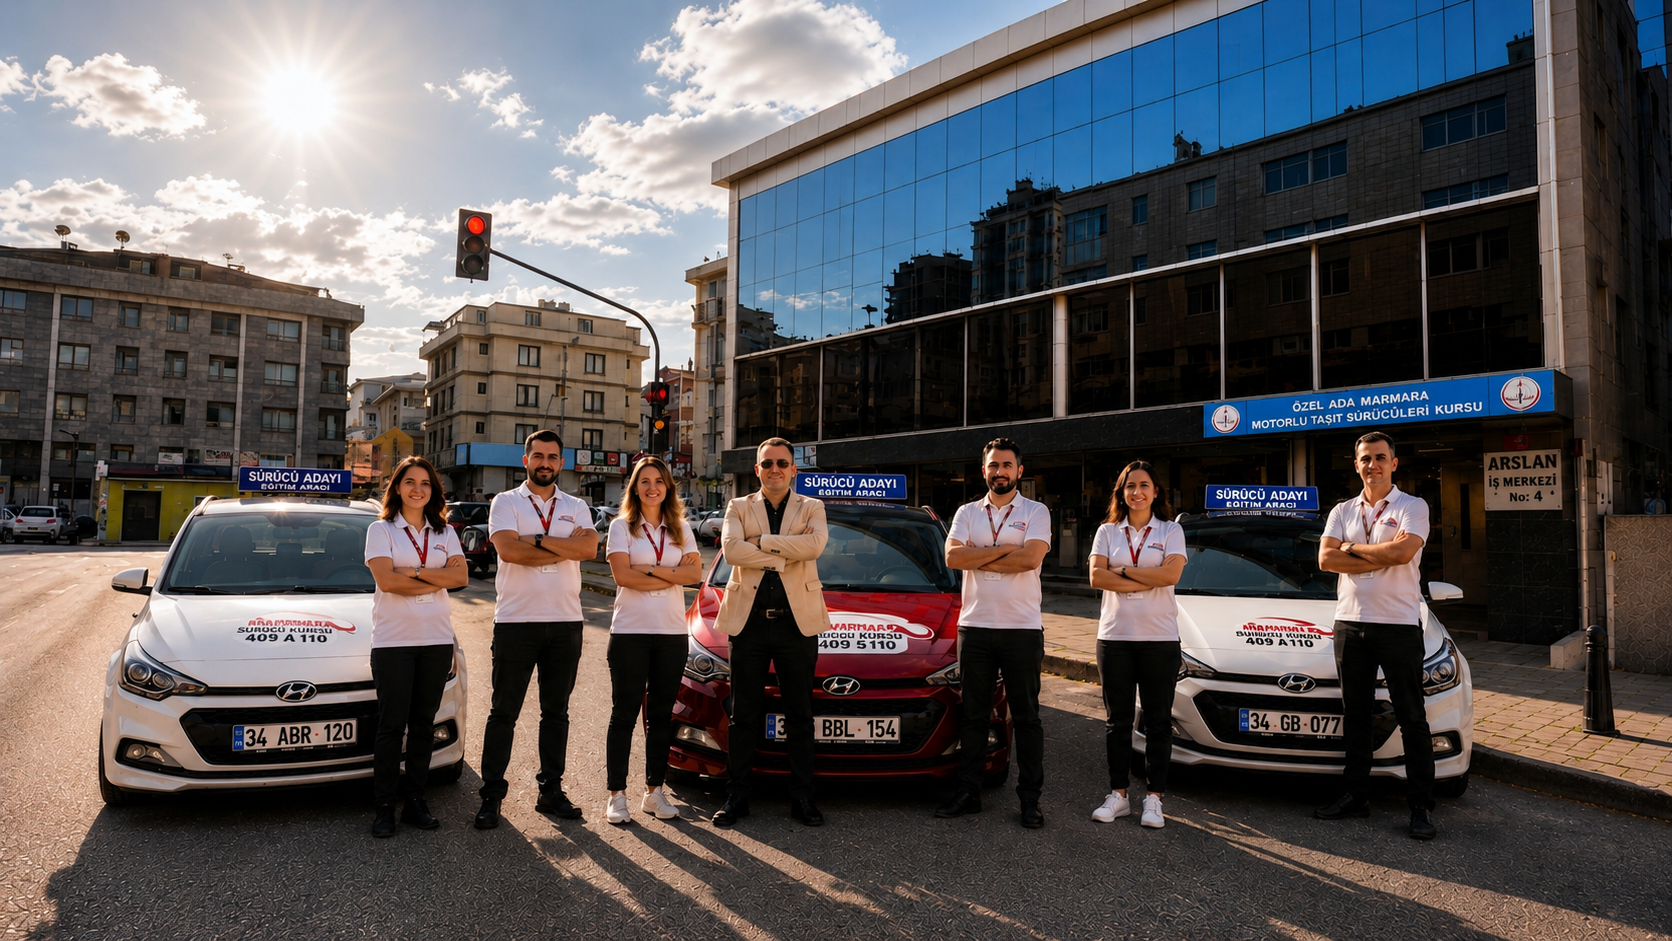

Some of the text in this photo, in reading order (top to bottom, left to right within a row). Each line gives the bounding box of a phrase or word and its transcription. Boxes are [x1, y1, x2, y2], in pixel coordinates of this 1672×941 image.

[1292, 391, 1429, 413] ÖZEL ADA MARMARA
[1251, 416, 1308, 430] MOTORLU
[1310, 413, 1343, 427] TAŞIT
[1435, 401, 1483, 416] KURSU
[1488, 454, 1557, 471] ARSLAN
[303, 473, 341, 484] ADAYI
[859, 478, 897, 489] ADAYI
[1488, 473, 1557, 491] İŞ MERKEZİ
[1270, 490, 1308, 501] ADAYI
[1509, 490, 1543, 503] No: 4
[245, 633, 278, 643] 409
[300, 634, 327, 643] 110
[818, 640, 850, 649] 409
[1246, 637, 1274, 646] 409
[822, 719, 855, 738] BBL
[866, 719, 897, 738] 154
[1250, 712, 1341, 734] 34 GB 077
[245, 722, 353, 747] 34 ABR 120
